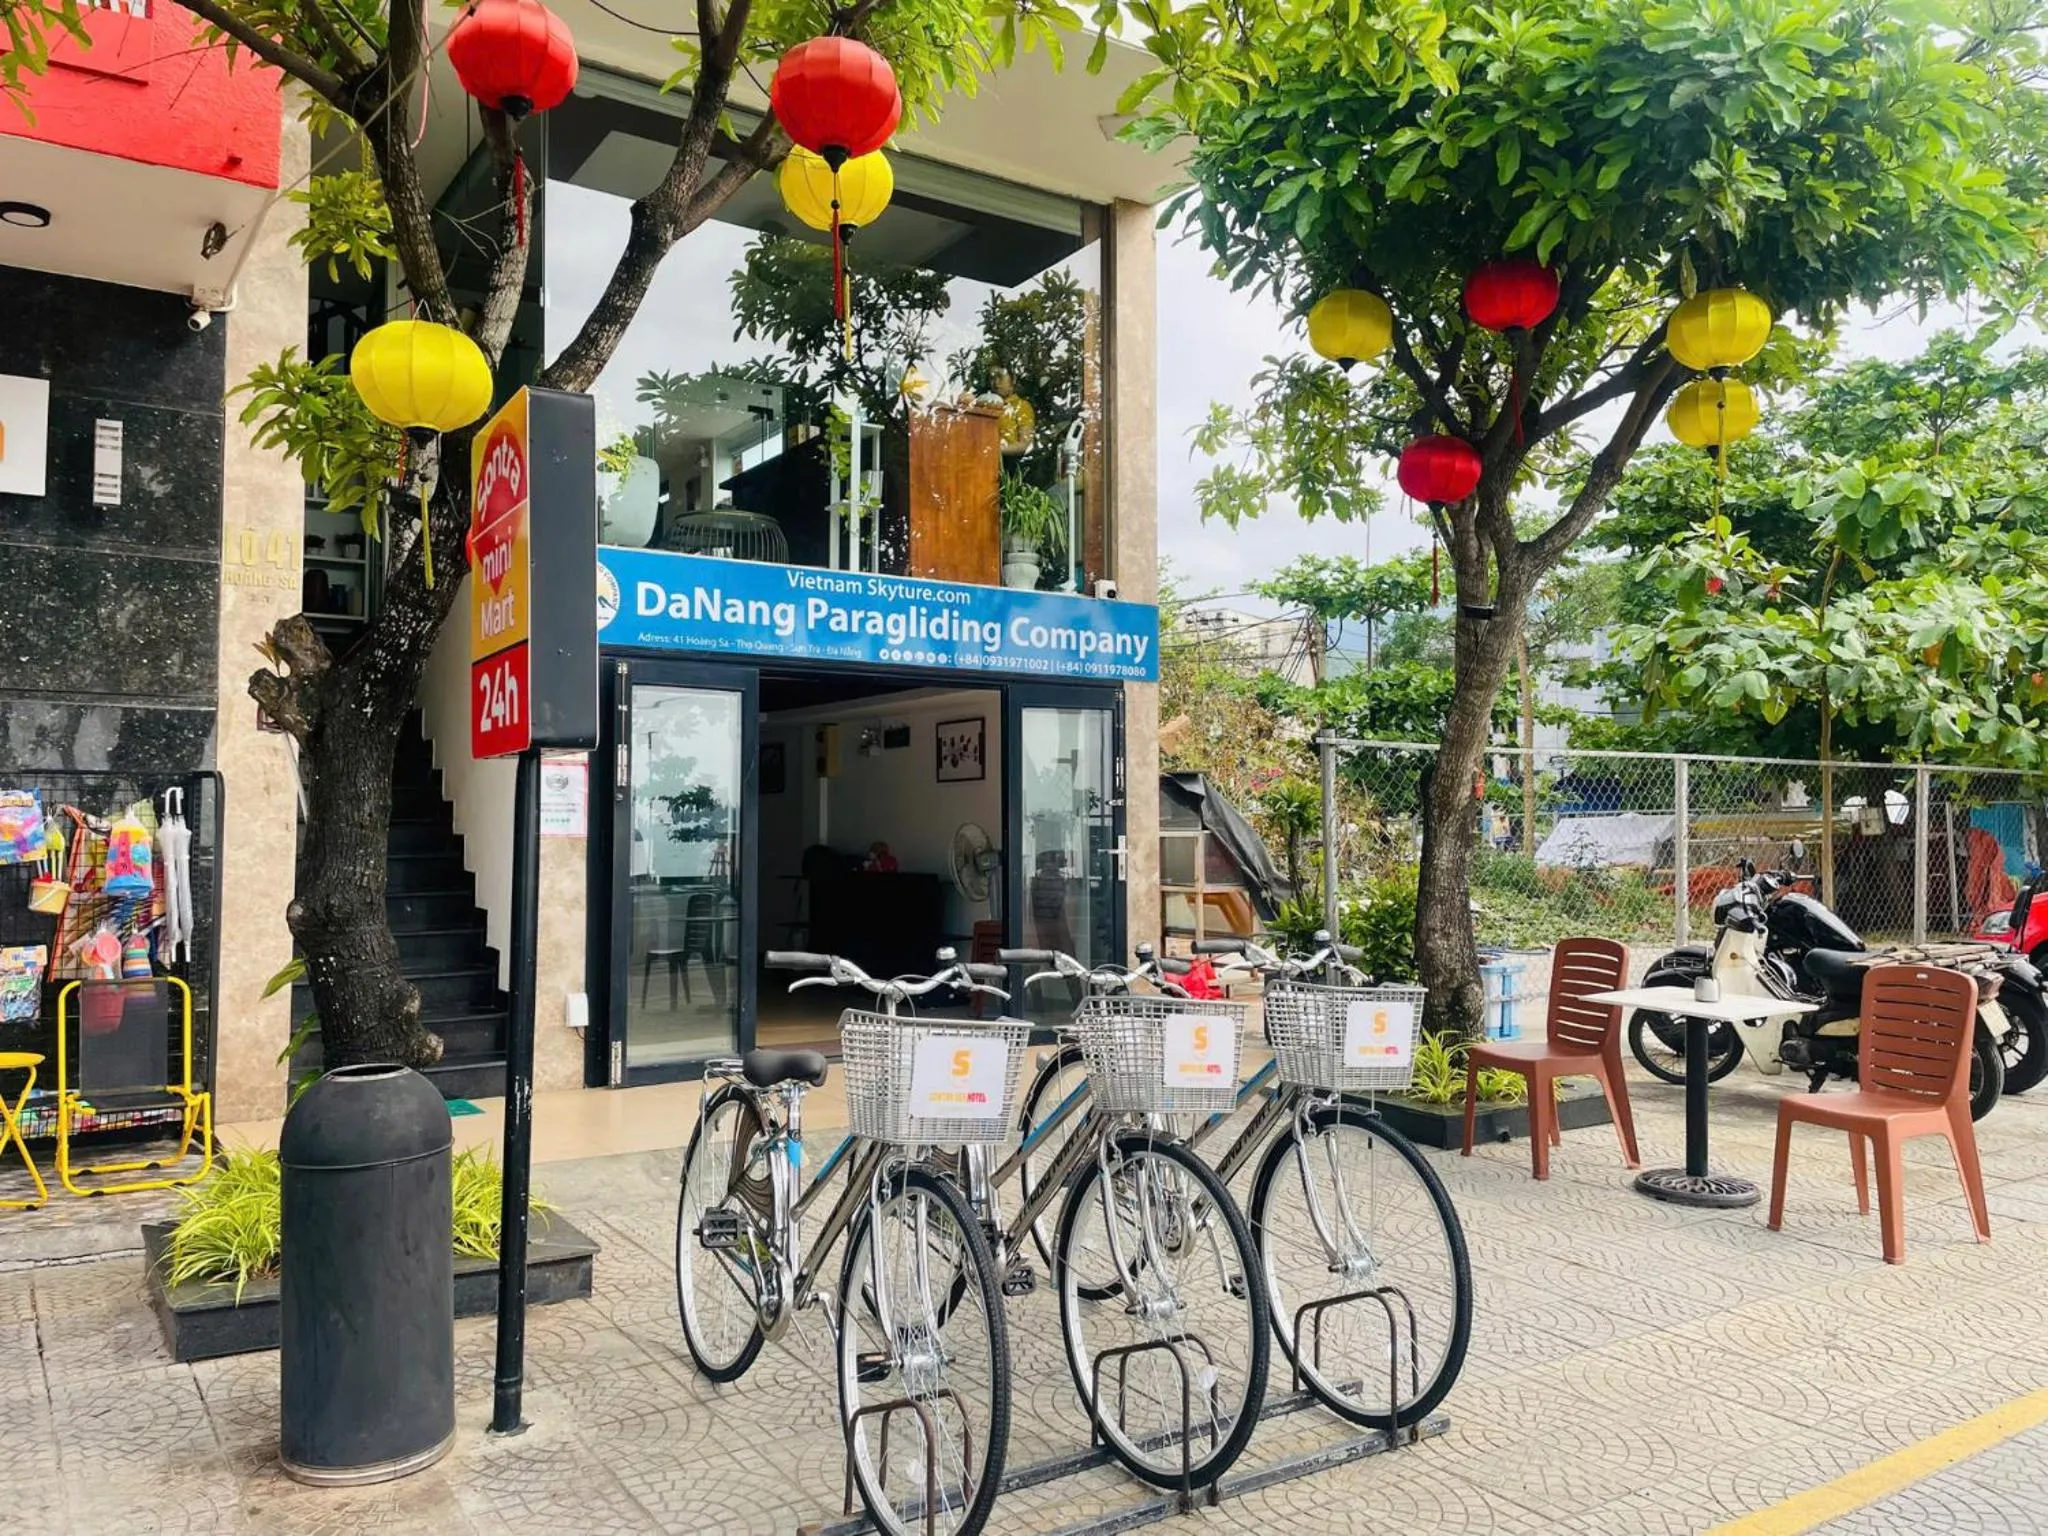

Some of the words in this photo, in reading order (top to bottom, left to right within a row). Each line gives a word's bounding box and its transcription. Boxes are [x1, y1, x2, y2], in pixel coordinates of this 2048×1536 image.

[266, 529, 299, 571] 41
[482, 525, 512, 584] mini
[787, 570, 861, 595] Vietnam
[867, 579, 971, 605] Skyture.com
[480, 588, 515, 641] Mart
[636, 581, 796, 636] DaNang
[807, 597, 1001, 652] Paragliding
[1010, 616, 1149, 664] Company
[479, 661, 519, 733] 24h
[1193, 1026, 1208, 1050] S
[951, 1049, 970, 1077] S
